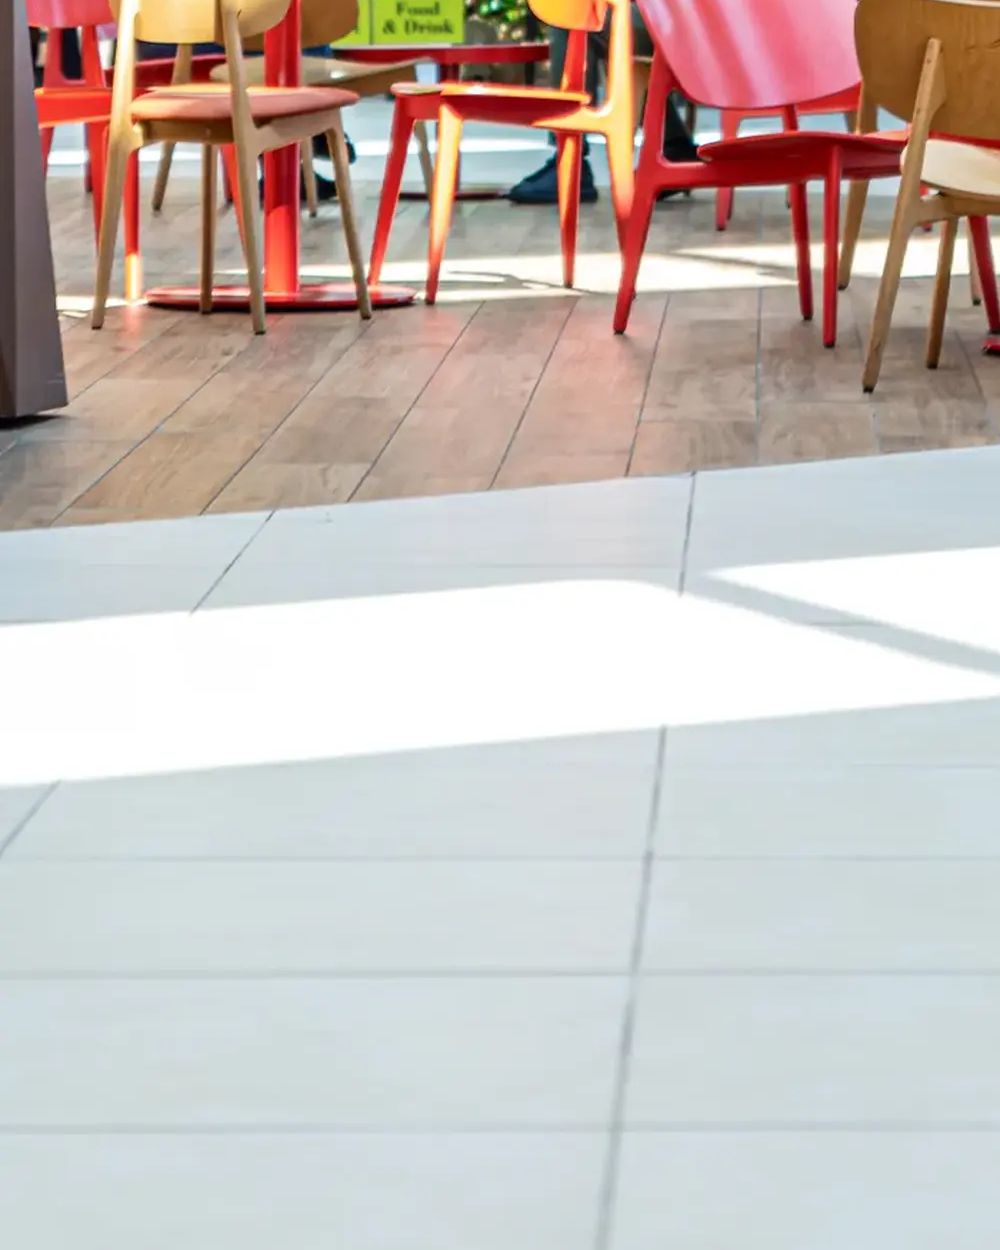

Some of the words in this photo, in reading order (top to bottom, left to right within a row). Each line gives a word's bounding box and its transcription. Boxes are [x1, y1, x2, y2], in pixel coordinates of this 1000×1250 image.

[396, 1, 440, 16] Food
[382, 19, 396, 35] &
[404, 18, 453, 35] Drink
